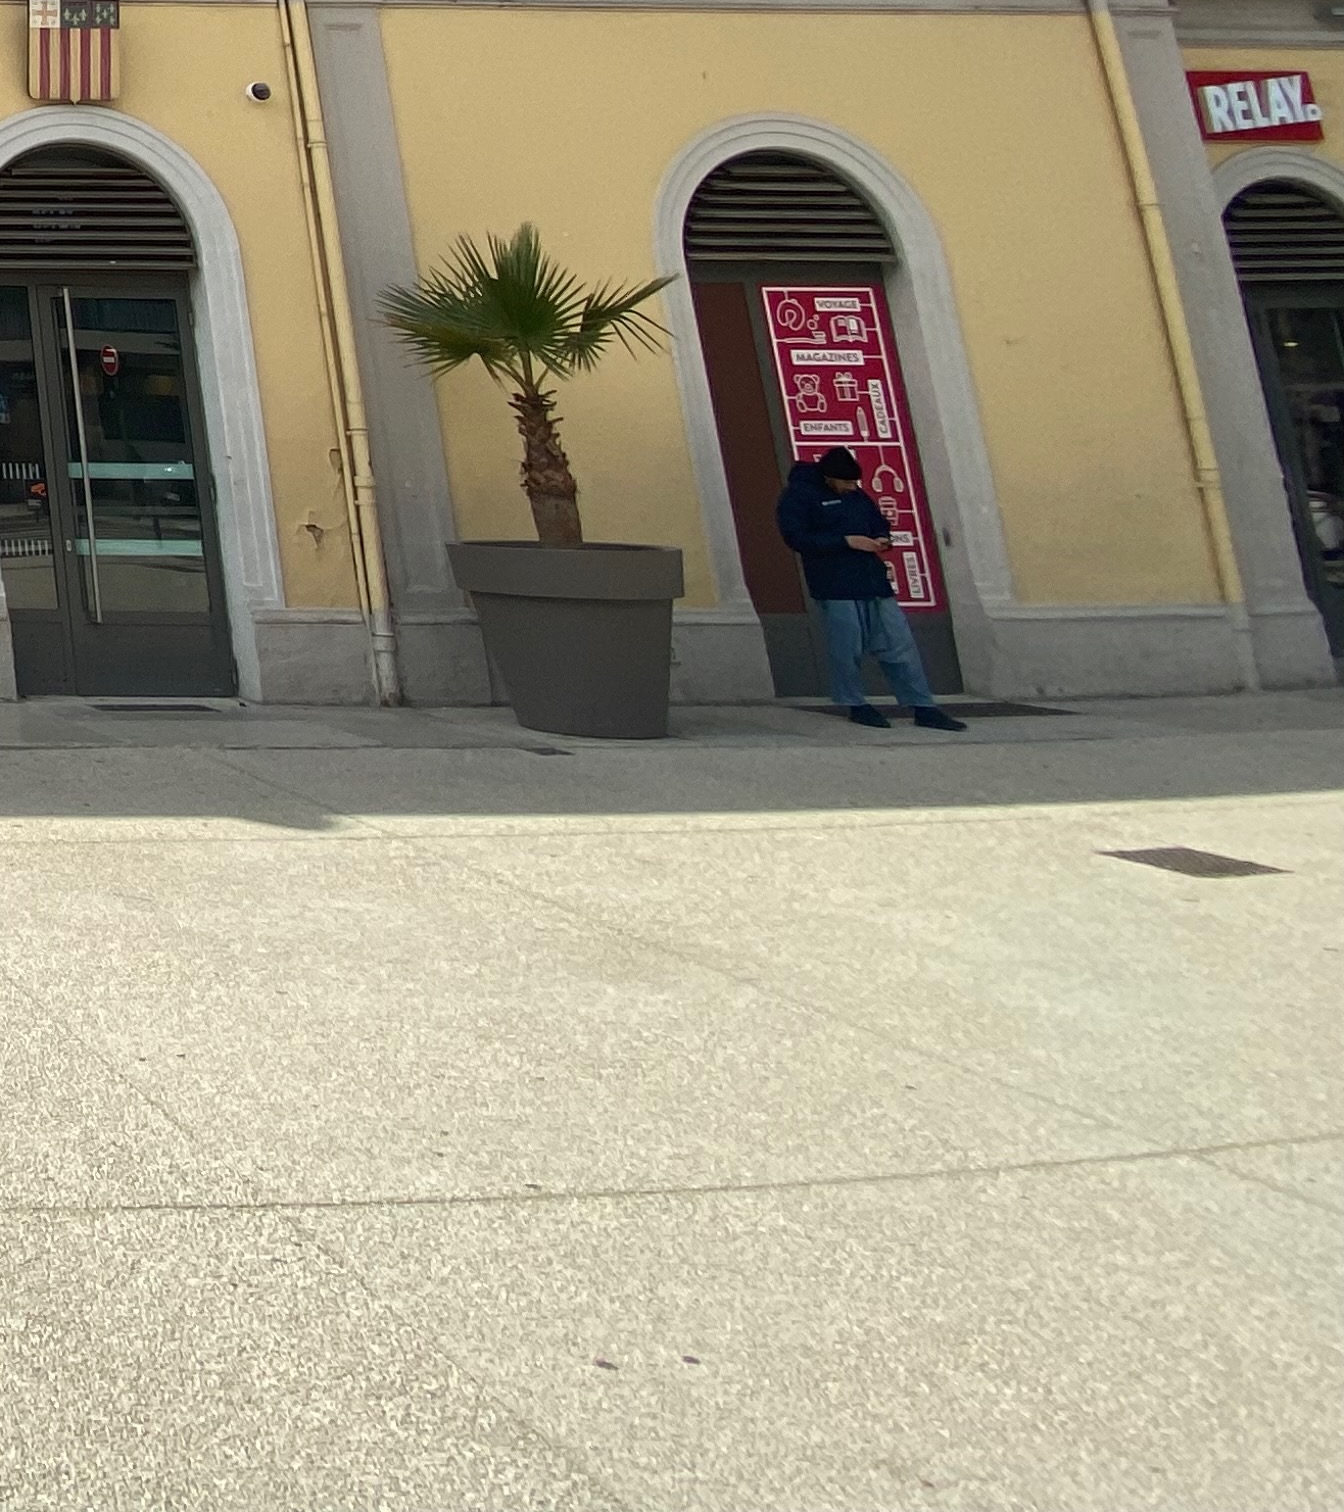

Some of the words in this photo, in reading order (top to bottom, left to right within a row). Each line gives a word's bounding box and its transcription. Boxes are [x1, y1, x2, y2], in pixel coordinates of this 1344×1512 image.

[816, 300, 858, 309] VOYAGE
[795, 352, 860, 363] MAGAZINES
[869, 382, 889, 434] CADEAUX
[802, 422, 850, 433] ENFANTS
